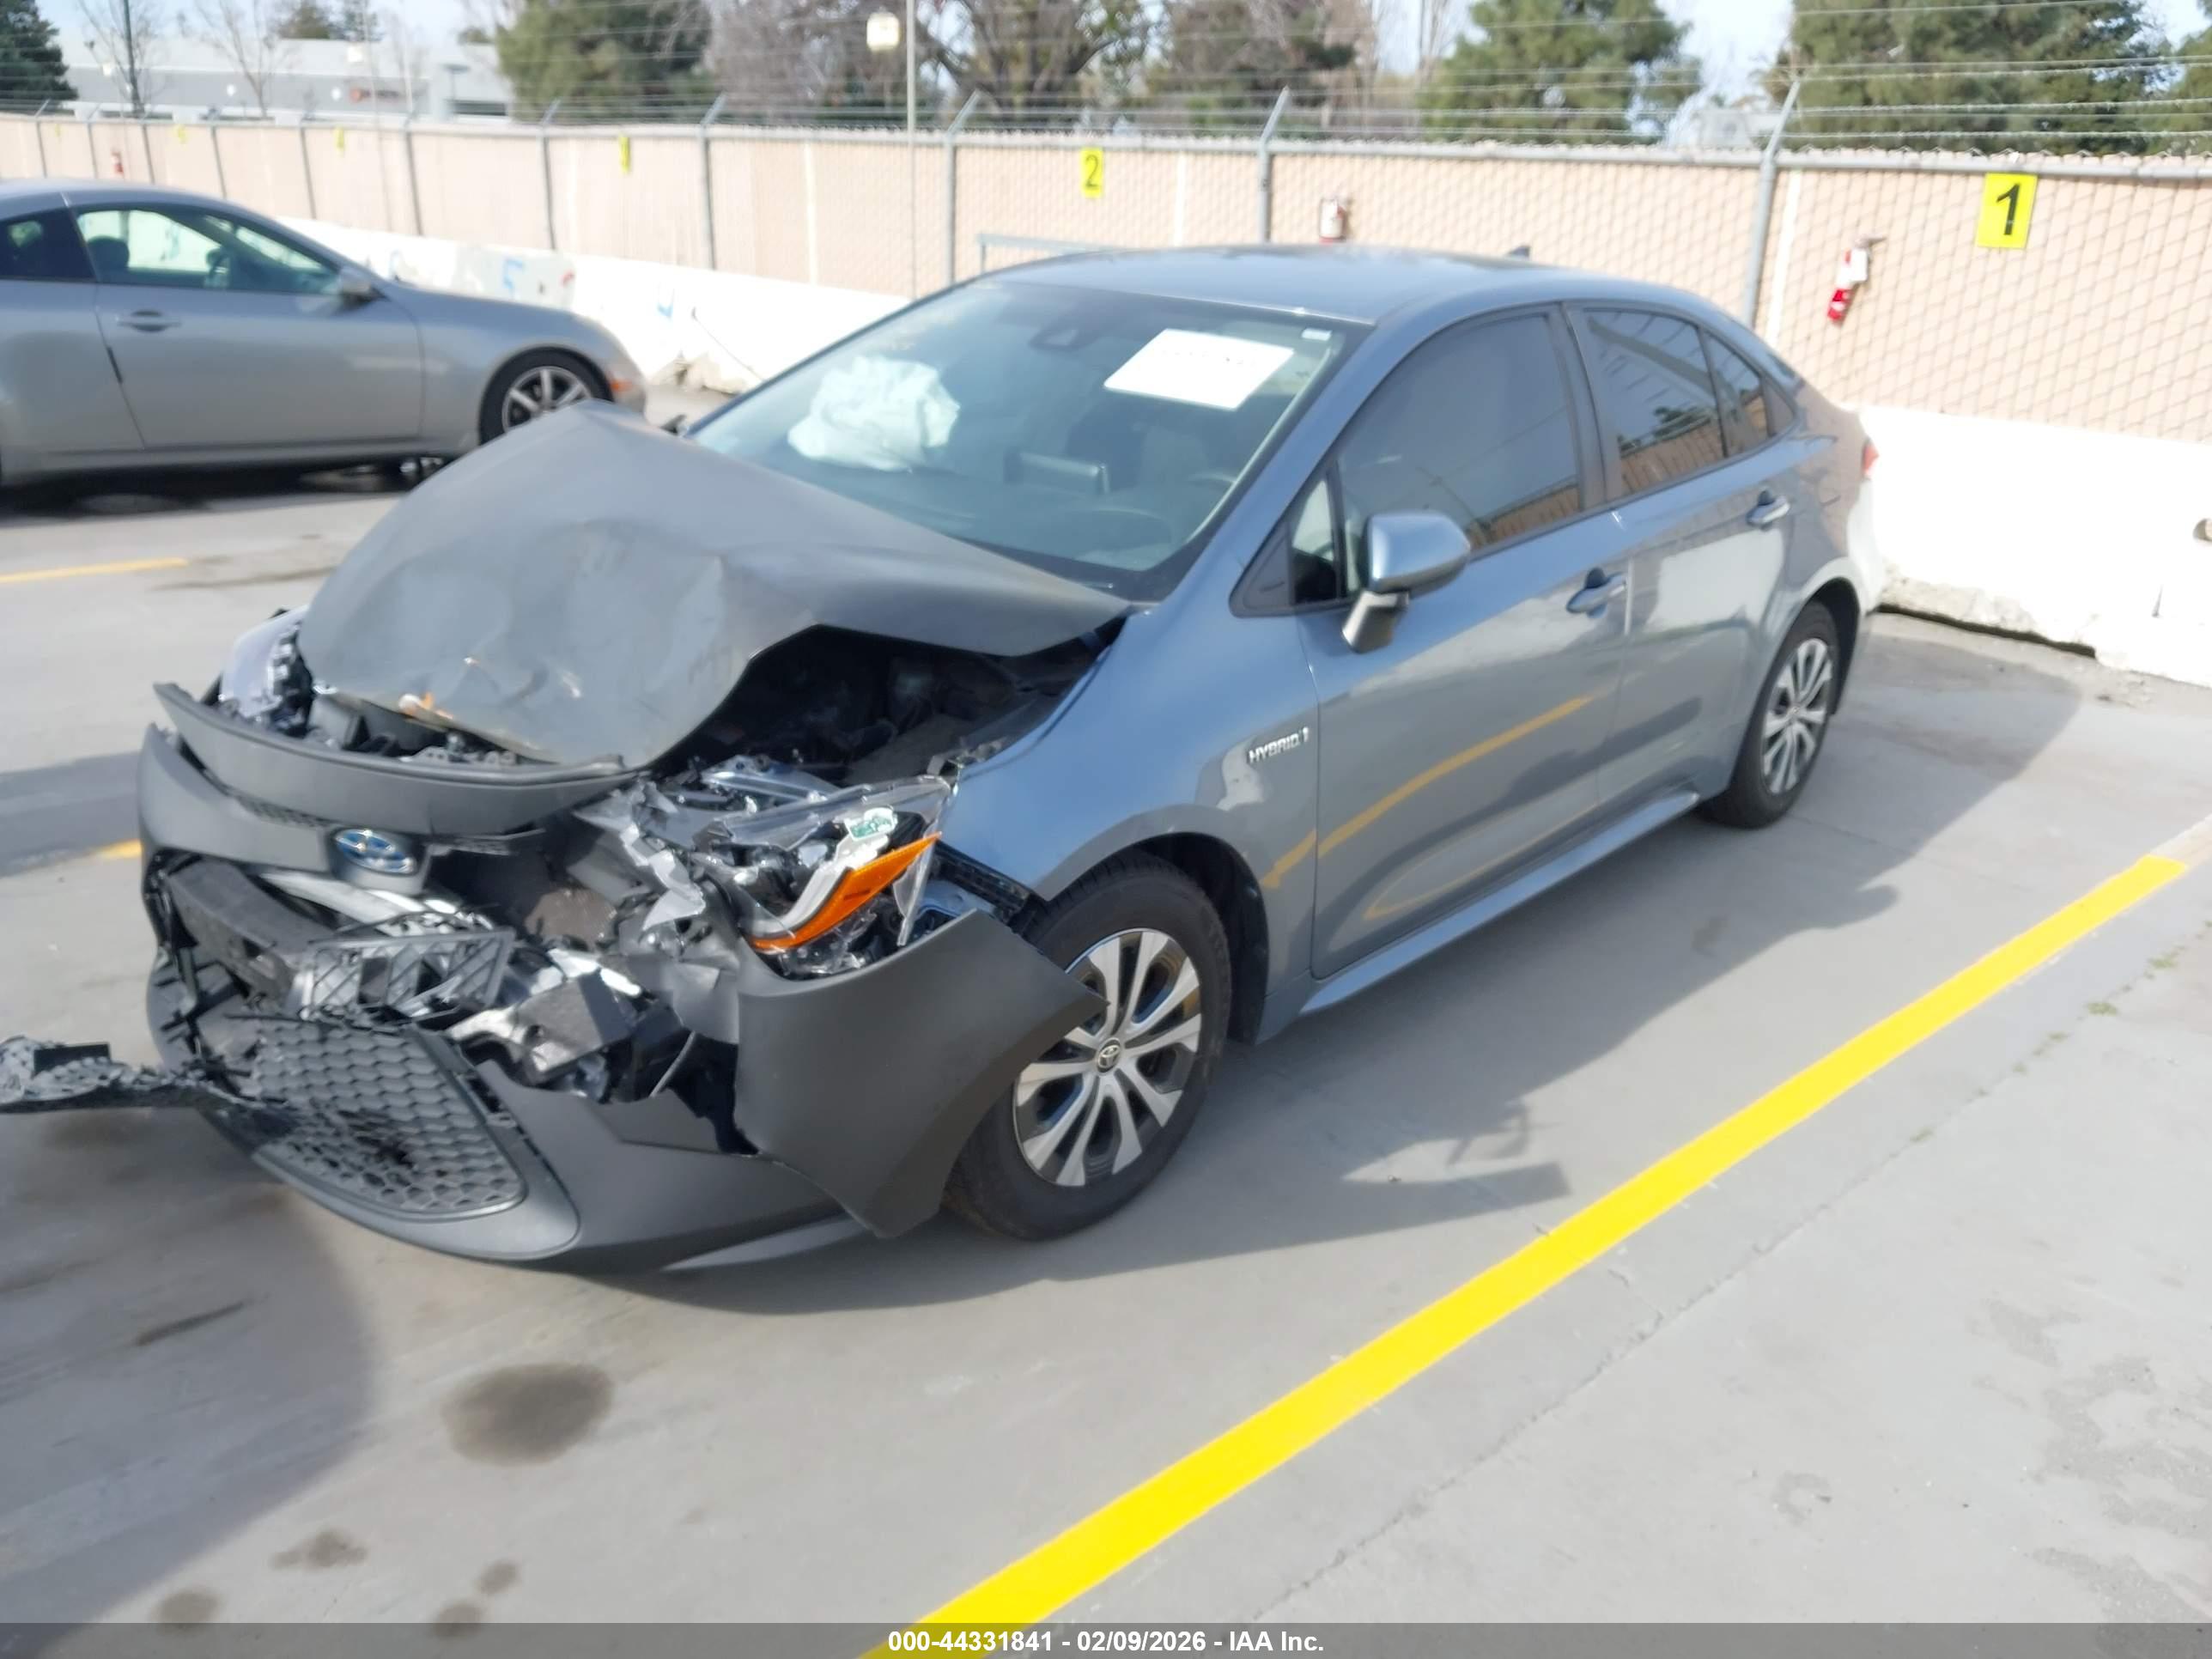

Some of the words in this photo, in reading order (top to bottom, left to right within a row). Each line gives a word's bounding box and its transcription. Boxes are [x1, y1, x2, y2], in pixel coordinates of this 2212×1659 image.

[1085, 154, 1099, 188] 2
[1996, 182, 2021, 235] 1
[1249, 732, 1299, 763] HYBRID
